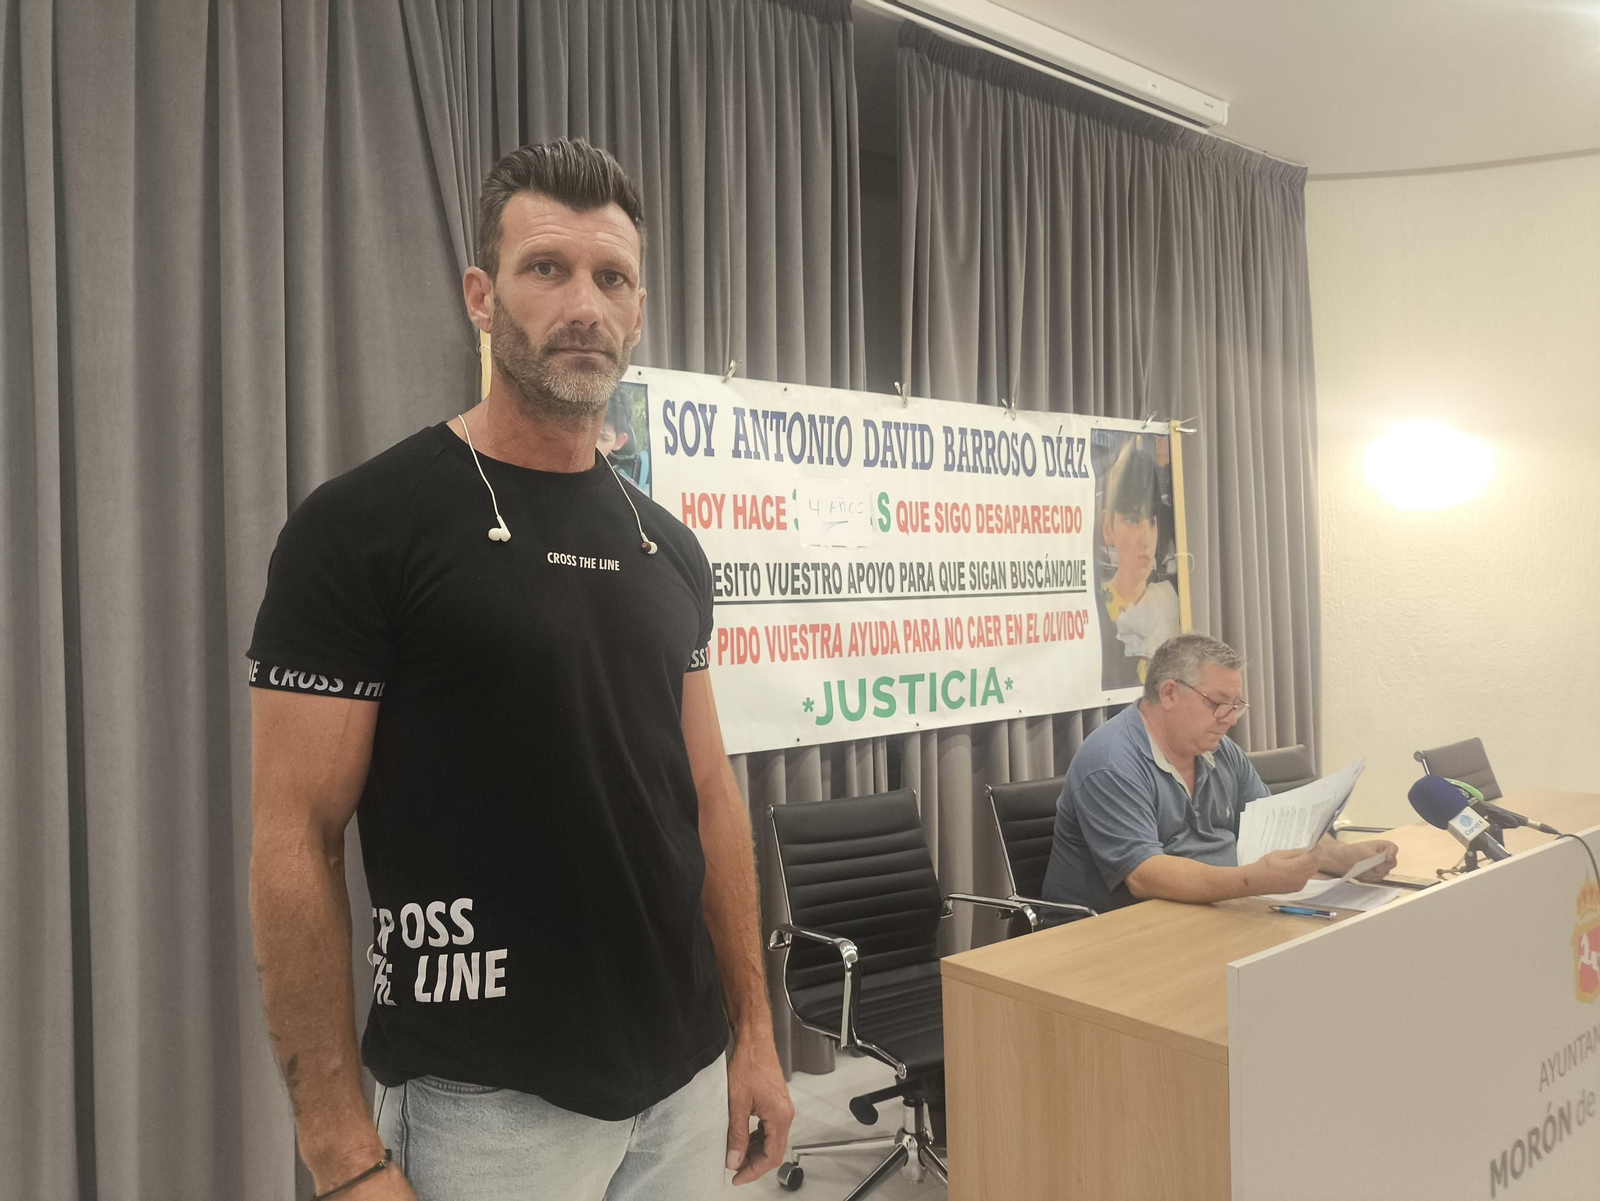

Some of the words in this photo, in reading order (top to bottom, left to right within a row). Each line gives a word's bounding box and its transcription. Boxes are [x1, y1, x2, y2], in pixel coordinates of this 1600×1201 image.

[662, 399, 718, 457] SOY
[732, 406, 853, 467] ANTONIO
[863, 418, 934, 471] DAVID
[942, 425, 1037, 478] BARROSO
[1041, 425, 1089, 479] DÍAZ
[681, 492, 726, 530] HOY
[732, 494, 788, 531] HACE
[896, 500, 931, 535] QUE
[934, 501, 971, 534] SIGO
[975, 503, 1082, 534] DESAPARECIDO
[547, 551, 577, 567] CROSS
[579, 556, 597, 569] THE
[599, 558, 620, 571] LINE
[766, 562, 843, 597] VUESTRO
[848, 561, 895, 594] APOYO
[899, 561, 936, 593] PARA
[939, 561, 966, 594] QUE
[969, 560, 1007, 591] SIGAN
[1010, 553, 1087, 589] BUSCÁNDOME
[717, 626, 761, 666] PIDO
[764, 623, 843, 663] VUESTRA
[848, 619, 901, 658] AYUDA
[903, 618, 942, 653] PARA
[944, 616, 964, 652] NO
[967, 614, 1003, 649] CAER
[1005, 613, 1023, 646] EN
[1026, 612, 1040, 644] EL
[414, 948, 508, 1003] LINE
[1489, 1100, 1572, 1200] MORÓN
[1576, 1088, 1597, 1127] de
